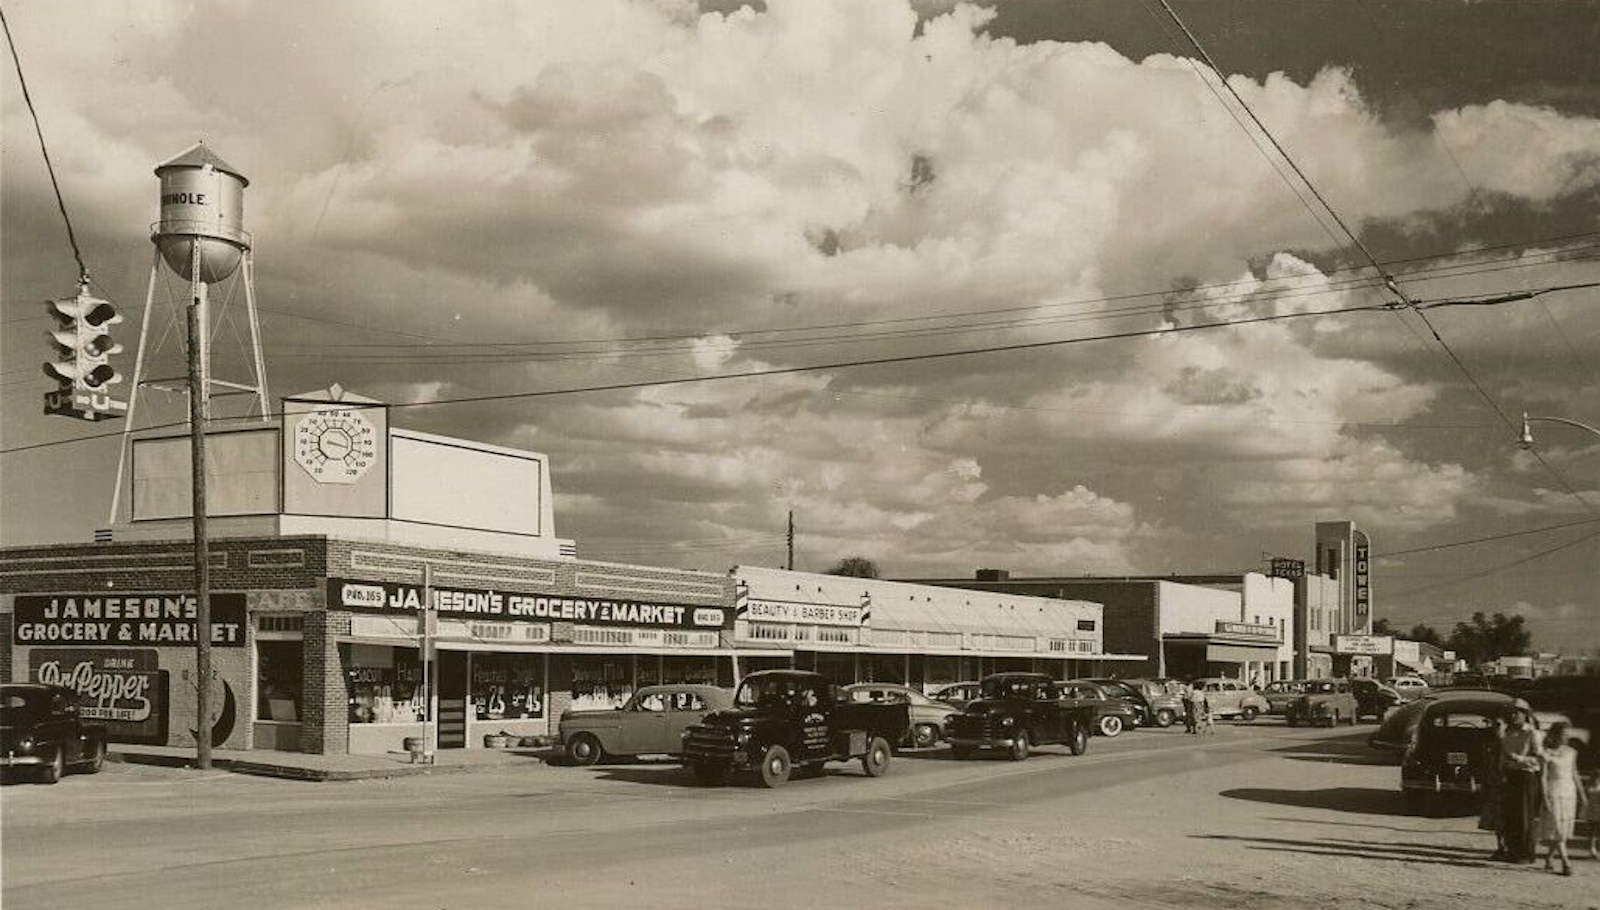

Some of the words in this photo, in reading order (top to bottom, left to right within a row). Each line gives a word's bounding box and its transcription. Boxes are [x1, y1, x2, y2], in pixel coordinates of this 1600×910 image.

[1357, 548, 1368, 615] TOWER
[44, 594, 197, 619] JAMESON'S
[508, 596, 600, 620] GROCERY
[612, 603, 685, 625] MARKET
[752, 603, 789, 616] BEAUTY
[802, 607, 834, 619] BARBER
[838, 609, 858, 621] SHOP
[18, 622, 111, 641] GROCERY
[118, 623, 132, 641] &
[103, 659, 135, 669] DRINK
[72, 661, 151, 709] Pepper
